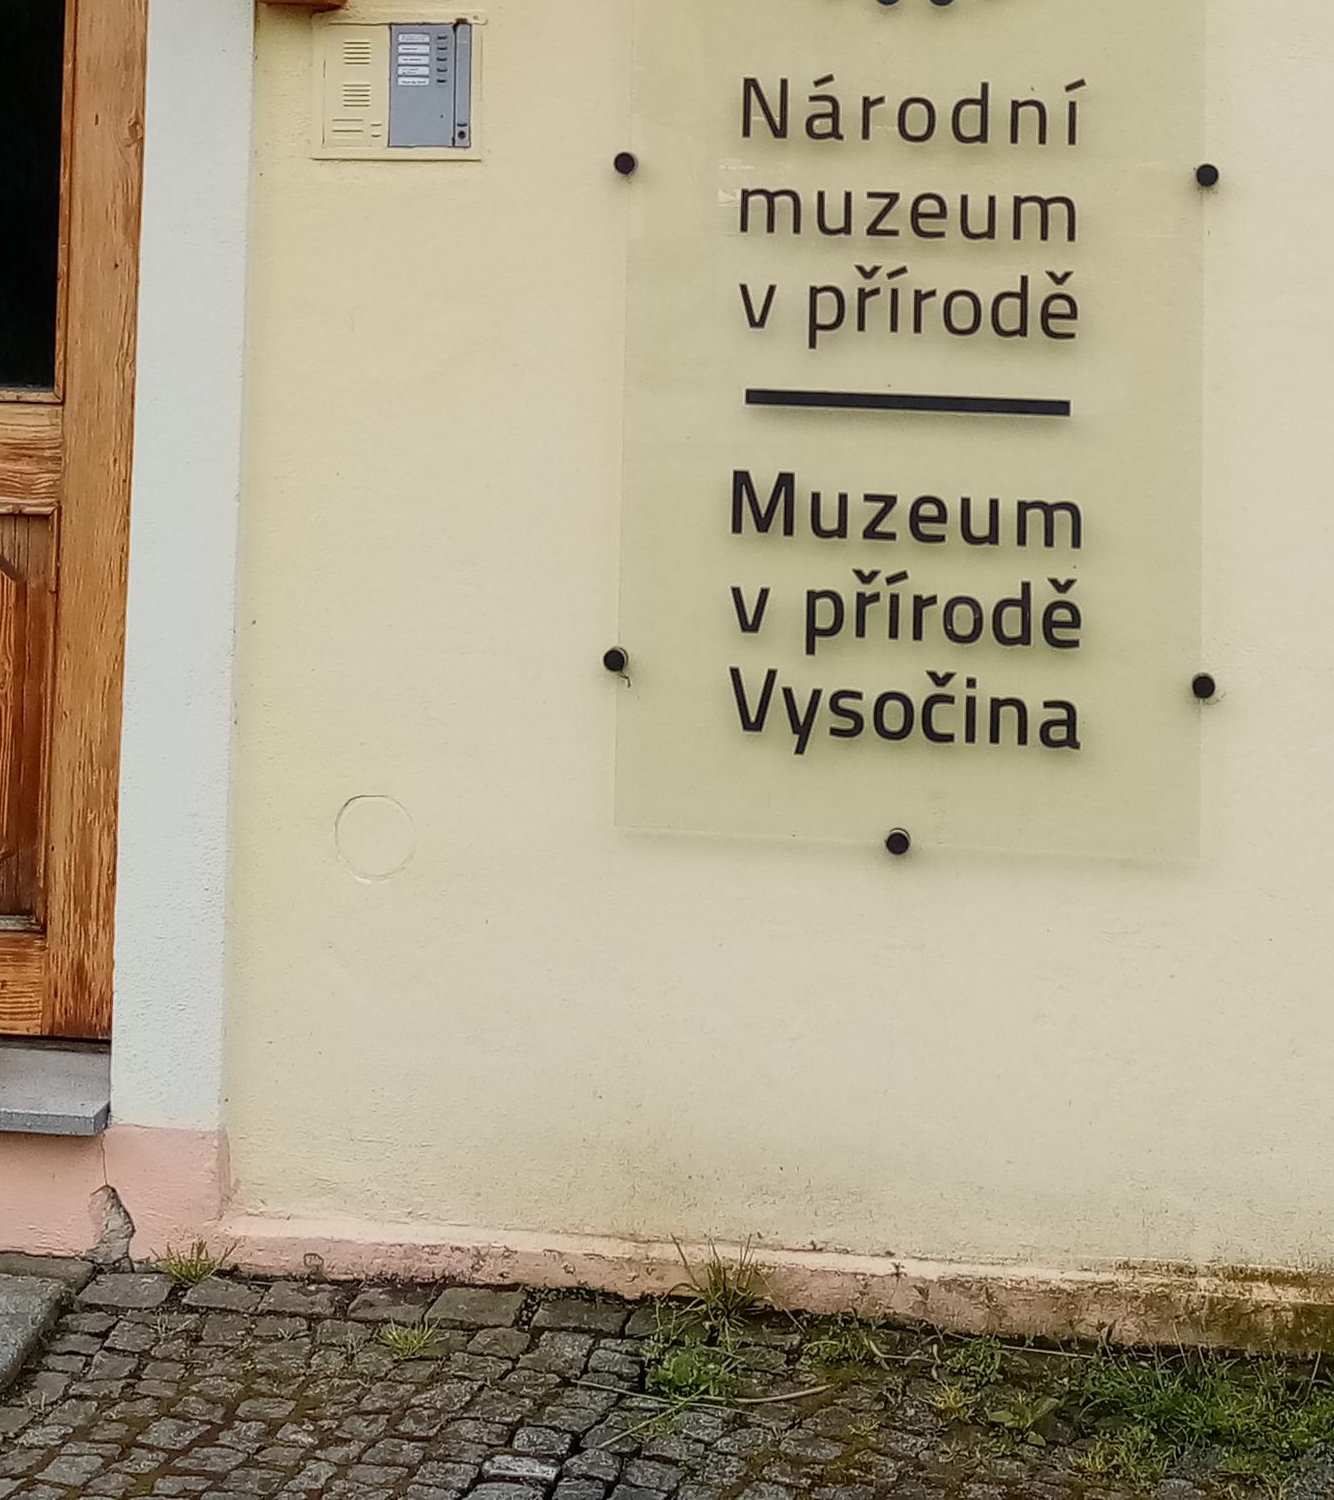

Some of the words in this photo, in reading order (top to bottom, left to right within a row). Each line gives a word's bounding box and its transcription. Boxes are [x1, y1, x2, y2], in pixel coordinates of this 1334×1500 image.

[741, 73, 1087, 147] Národní
[738, 187, 1077, 243] muzeum
[739, 282, 778, 330] v
[807, 264, 1079, 350] přírodě
[730, 469, 1083, 550] Muzeum
[729, 585, 771, 635] v
[805, 568, 1083, 656] přírodě
[729, 666, 1082, 756] Vysočina
